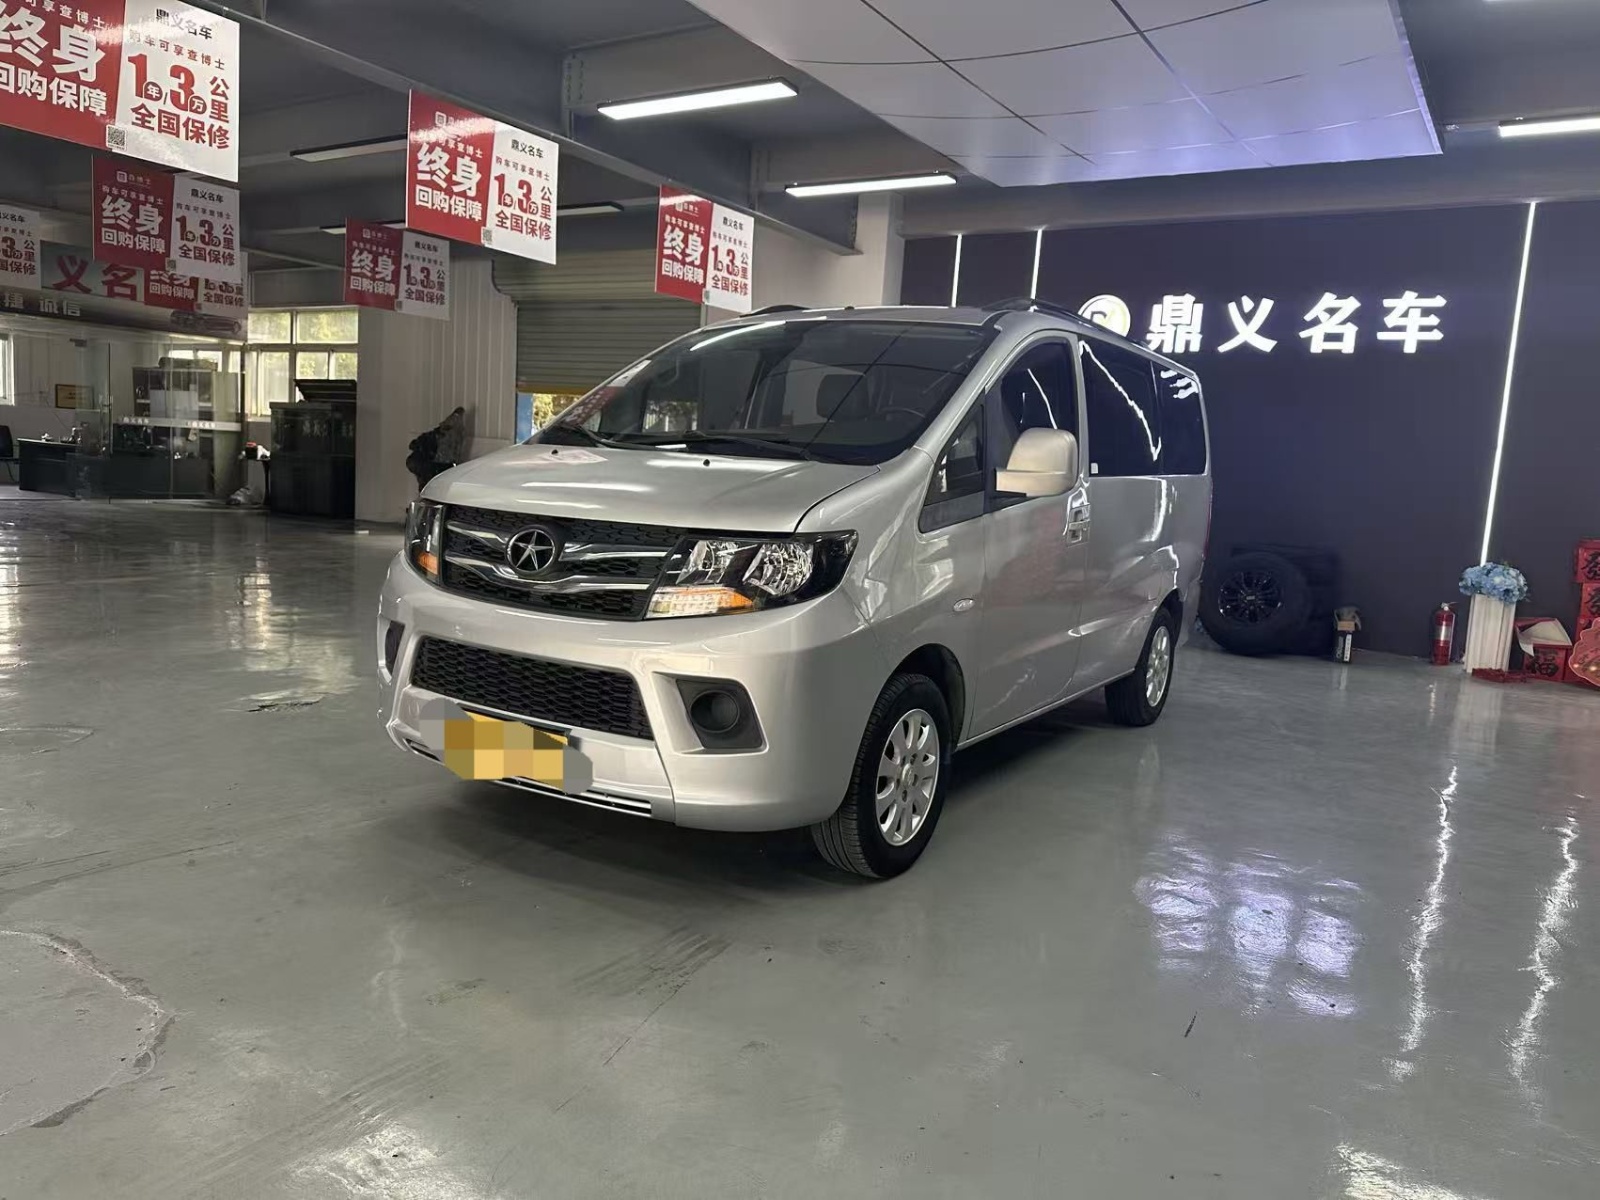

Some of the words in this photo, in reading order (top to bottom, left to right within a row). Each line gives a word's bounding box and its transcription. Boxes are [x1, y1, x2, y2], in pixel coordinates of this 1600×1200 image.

[156, 8, 213, 40] 鼎义名车
[0, 1, 106, 82] 终身
[129, 29, 225, 70] 购车可享查博士
[131, 102, 230, 150] 全国保修
[511, 139, 544, 159] 鼎义名车
[417, 142, 482, 198] 终身
[191, 188, 224, 203] 鼎义名车
[415, 184, 483, 223] 回购保障
[0, 211, 25, 222] 义名车
[101, 194, 164, 235] 终身
[495, 210, 552, 241] 全国保修
[101, 227, 166, 255] 回购保障
[179, 244, 235, 267] 全国保修
[663, 224, 704, 266] 终身
[351, 249, 396, 282] 终身
[661, 258, 704, 285] 回购保障
[150, 283, 194, 300] 回购保障
[203, 292, 245, 307] 全国保修
[350, 275, 396, 297] 回购保障
[405, 287, 445, 305] 全国保修
[711, 274, 748, 297] 全国保修
[1146, 289, 1447, 354] 鼎义名车
